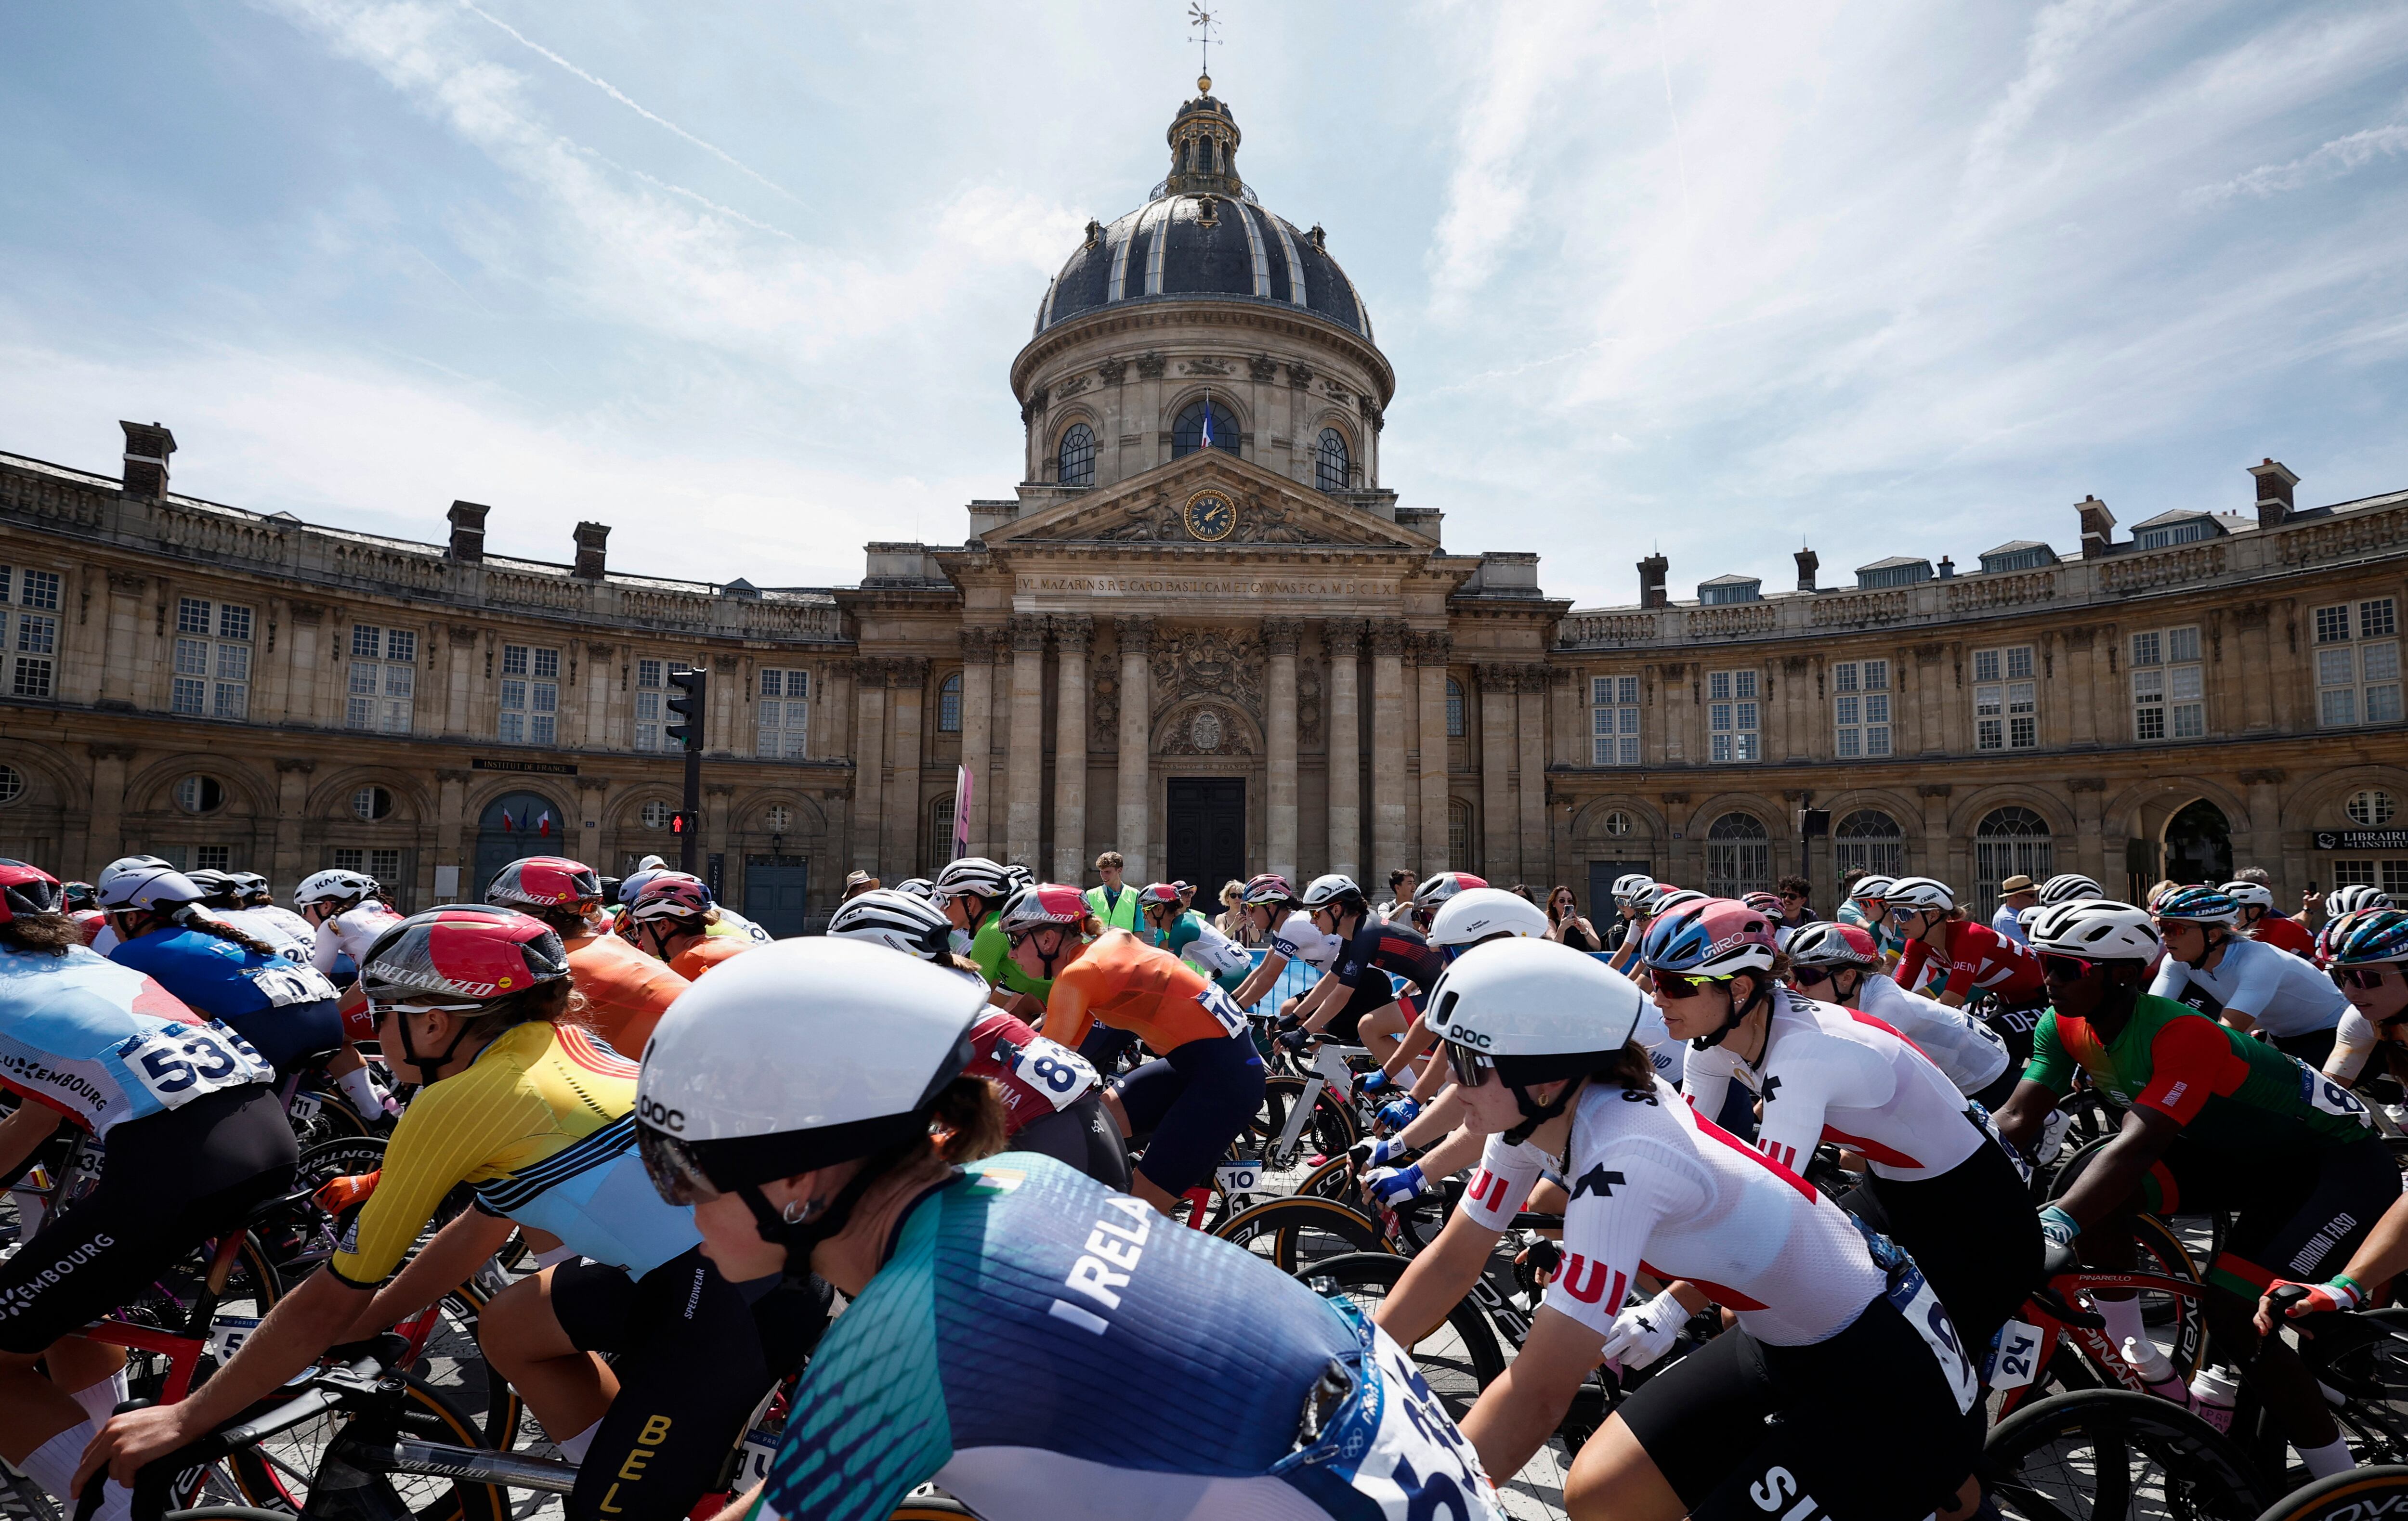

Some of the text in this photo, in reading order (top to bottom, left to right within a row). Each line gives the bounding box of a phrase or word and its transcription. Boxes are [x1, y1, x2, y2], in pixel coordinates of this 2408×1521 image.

[484, 761, 521, 770] INSTITUT
[537, 764, 567, 773] FRANCE
[2344, 832, 2408, 841] LIBRAIRI
[314, 873, 347, 890] KASK
[1332, 884, 1347, 893] LAZER
[489, 885, 557, 905] SPECIALIZED
[1011, 910, 1074, 923] SPECIALIZED
[1277, 941, 1296, 955] USA
[1701, 931, 1744, 959] GIRO
[1814, 947, 1872, 962] SPECIALIZED
[369, 960, 496, 997] SPECIALIZED
[140, 1037, 236, 1093] 53
[296, 1100, 311, 1116] 11
[1228, 1171, 1254, 1189] 10
[2289, 1212, 2357, 1276] BURKINA FASO
[684, 1268, 705, 1319] SPEEDWEAR
[2002, 1336, 2035, 1379] 24
[391, 1459, 490, 1478] SPECIALIZED
[600, 1415, 672, 1521] BEL
